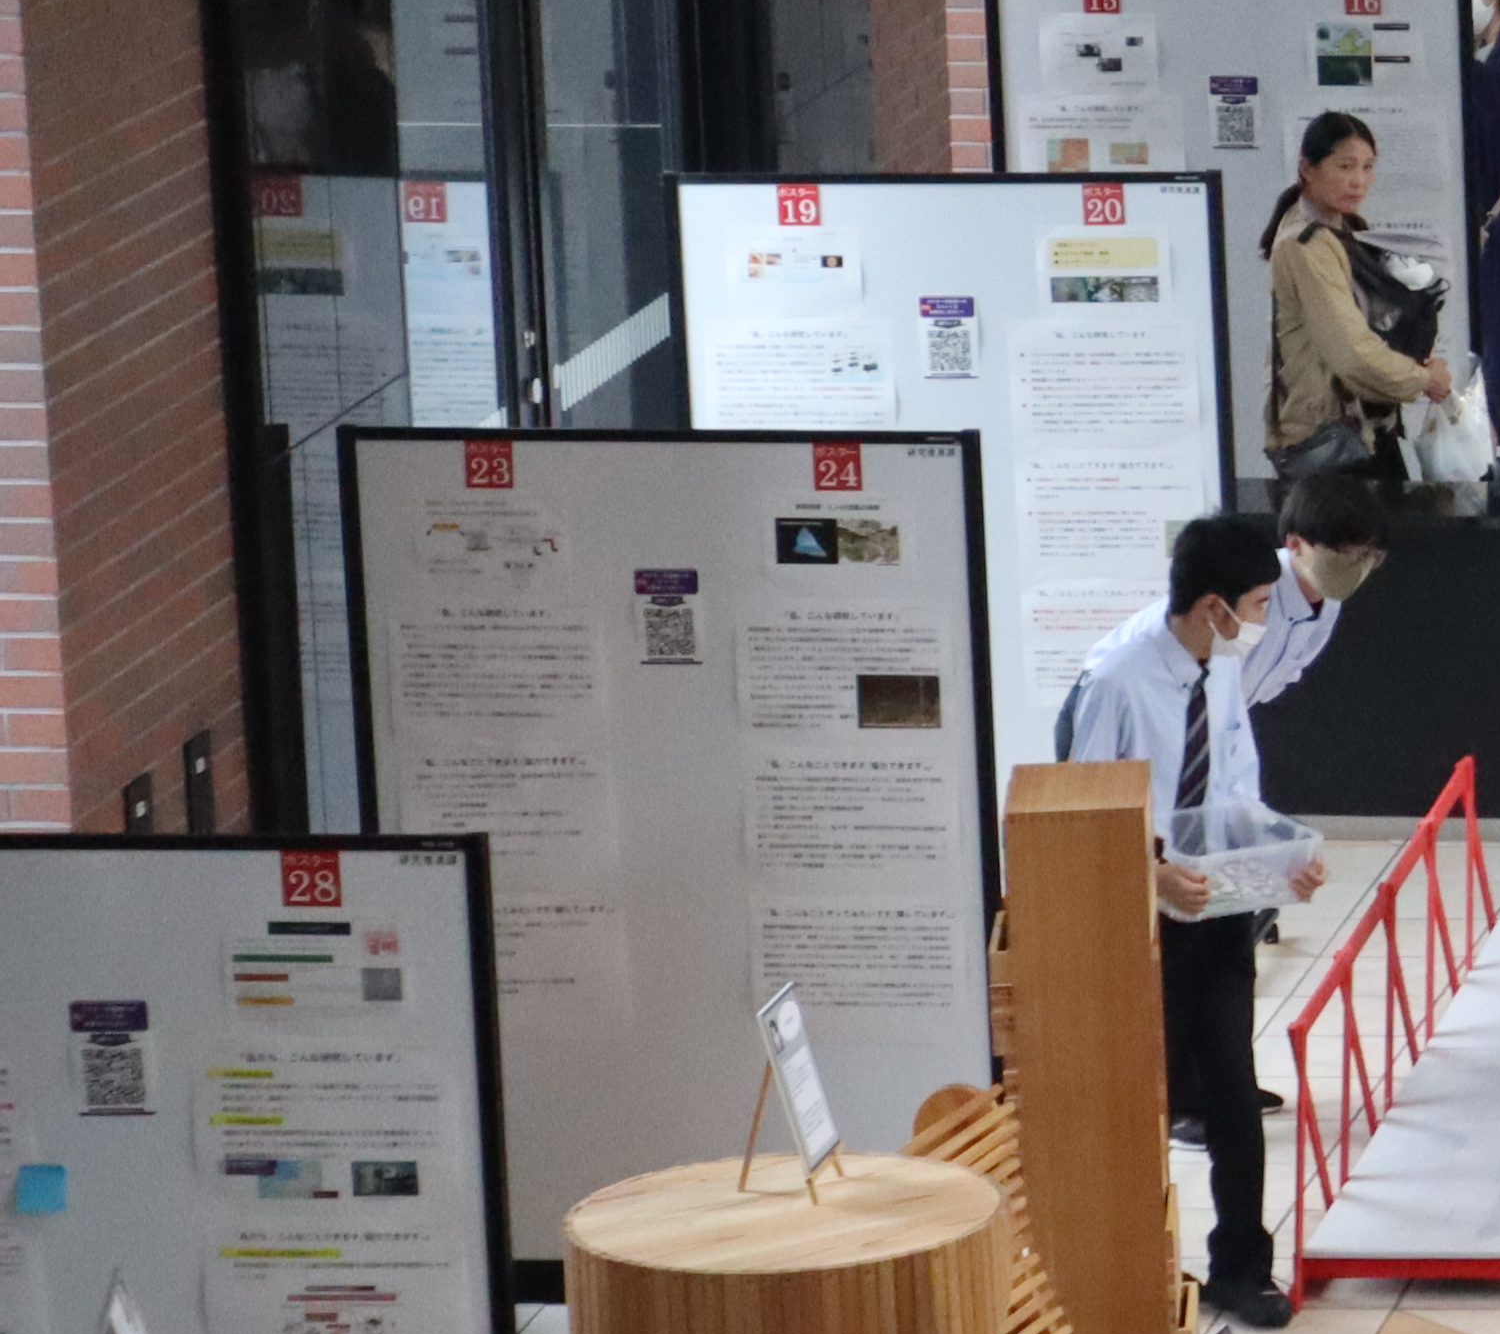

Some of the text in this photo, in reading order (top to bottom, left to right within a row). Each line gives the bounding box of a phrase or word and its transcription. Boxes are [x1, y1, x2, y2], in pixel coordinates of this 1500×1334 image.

[782, 199, 817, 224] 19
[1086, 198, 1123, 223] 20
[470, 457, 510, 485] 23
[818, 459, 858, 487] 24
[288, 869, 338, 904] 28
